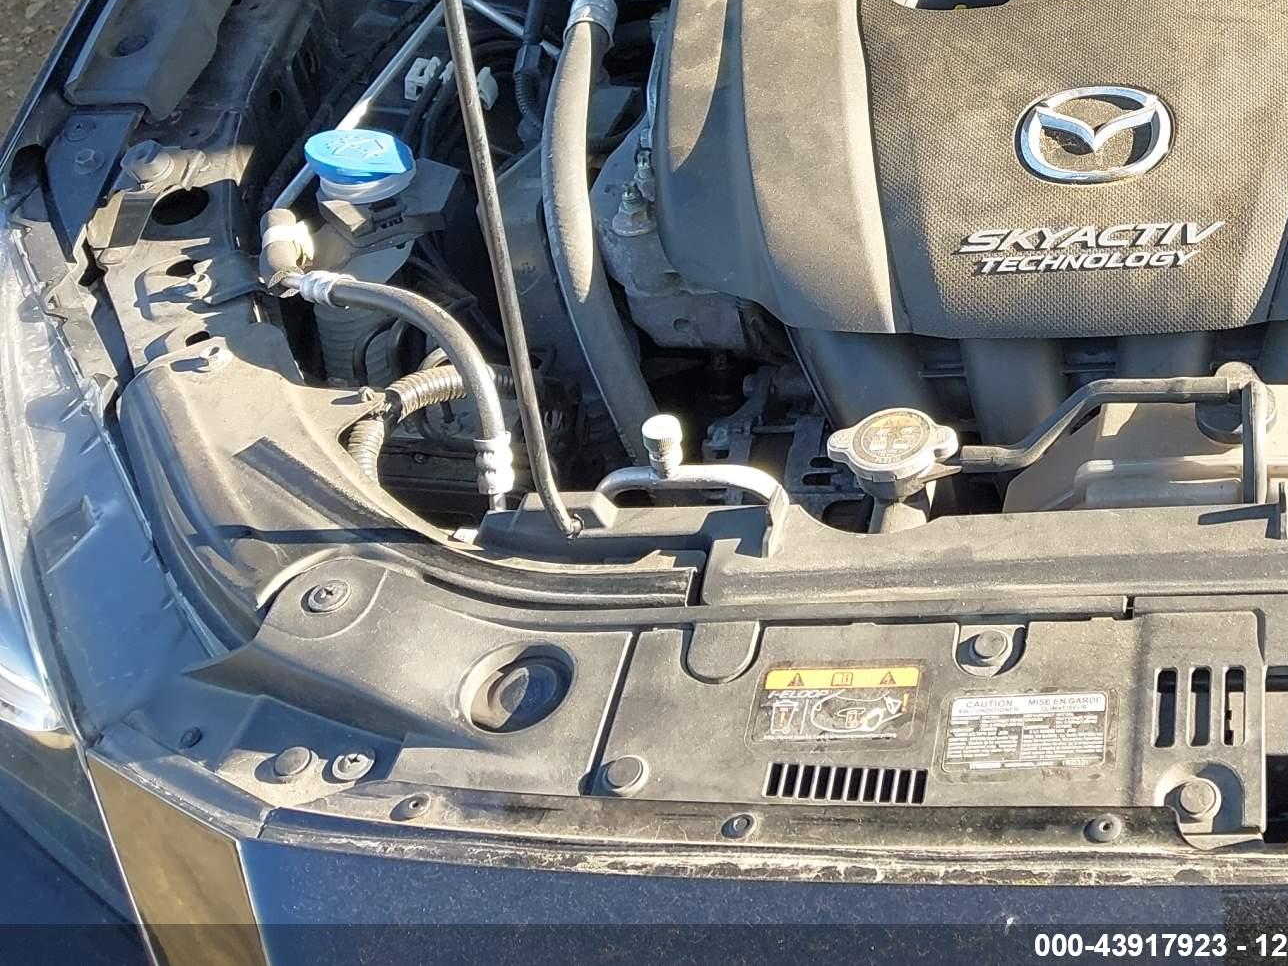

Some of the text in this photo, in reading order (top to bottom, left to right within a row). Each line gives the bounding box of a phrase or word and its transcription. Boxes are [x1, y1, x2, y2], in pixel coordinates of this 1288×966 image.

[957, 221, 1226, 254] SKYACTIV
[979, 249, 1201, 275] TECHNOLOGY
[966, 699, 1013, 708] CAUTION
[1027, 698, 1051, 706] MISE
